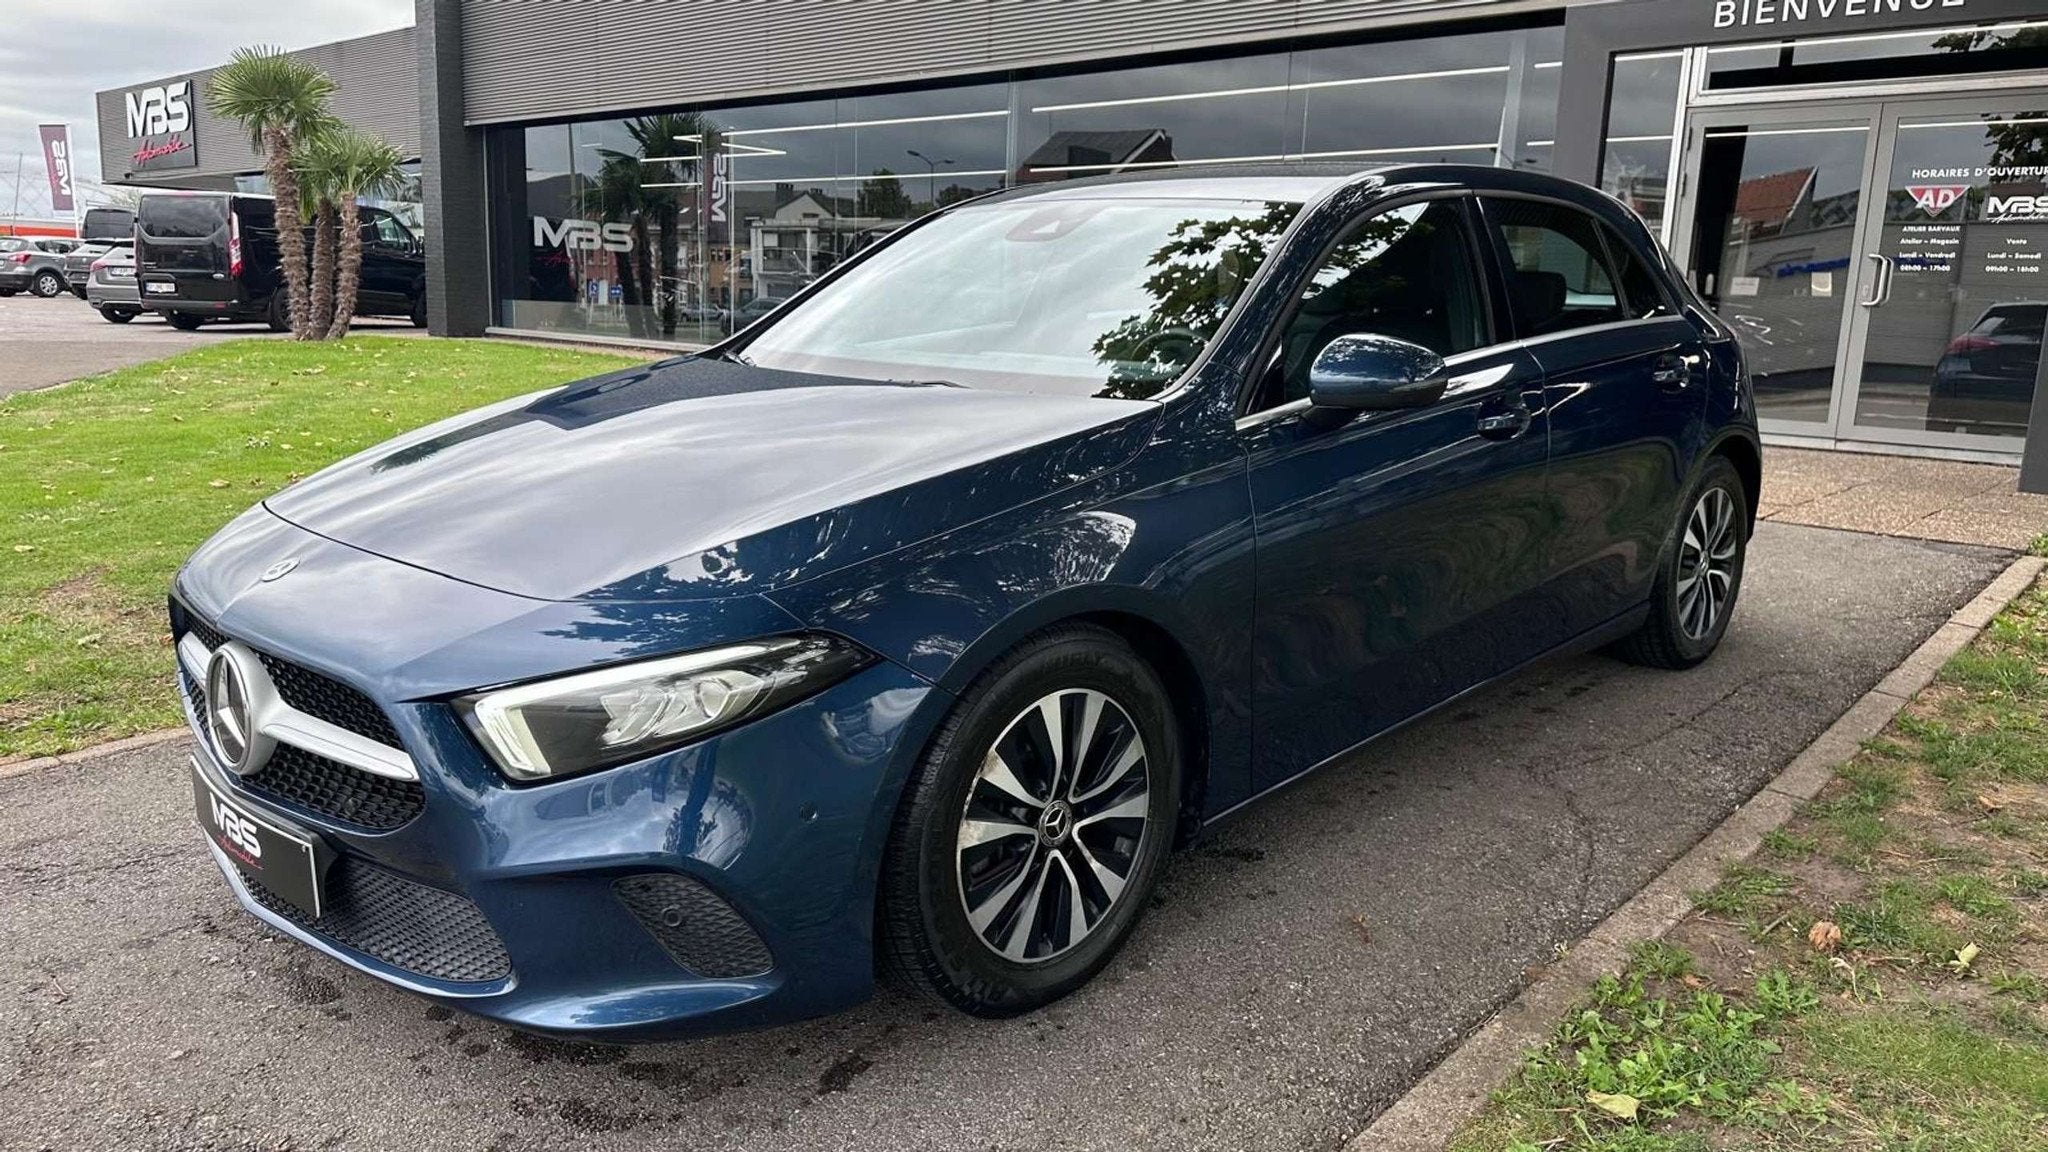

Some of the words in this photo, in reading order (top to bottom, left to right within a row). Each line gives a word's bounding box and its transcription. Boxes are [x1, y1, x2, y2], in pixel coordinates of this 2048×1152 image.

[1713, 0, 1965, 28] BIENVE
[125, 81, 191, 139] MBS
[1912, 168, 1970, 179] HORAIRES
[1915, 189, 1955, 209] AD
[533, 215, 634, 253] MBS
[210, 791, 262, 859] MBS
